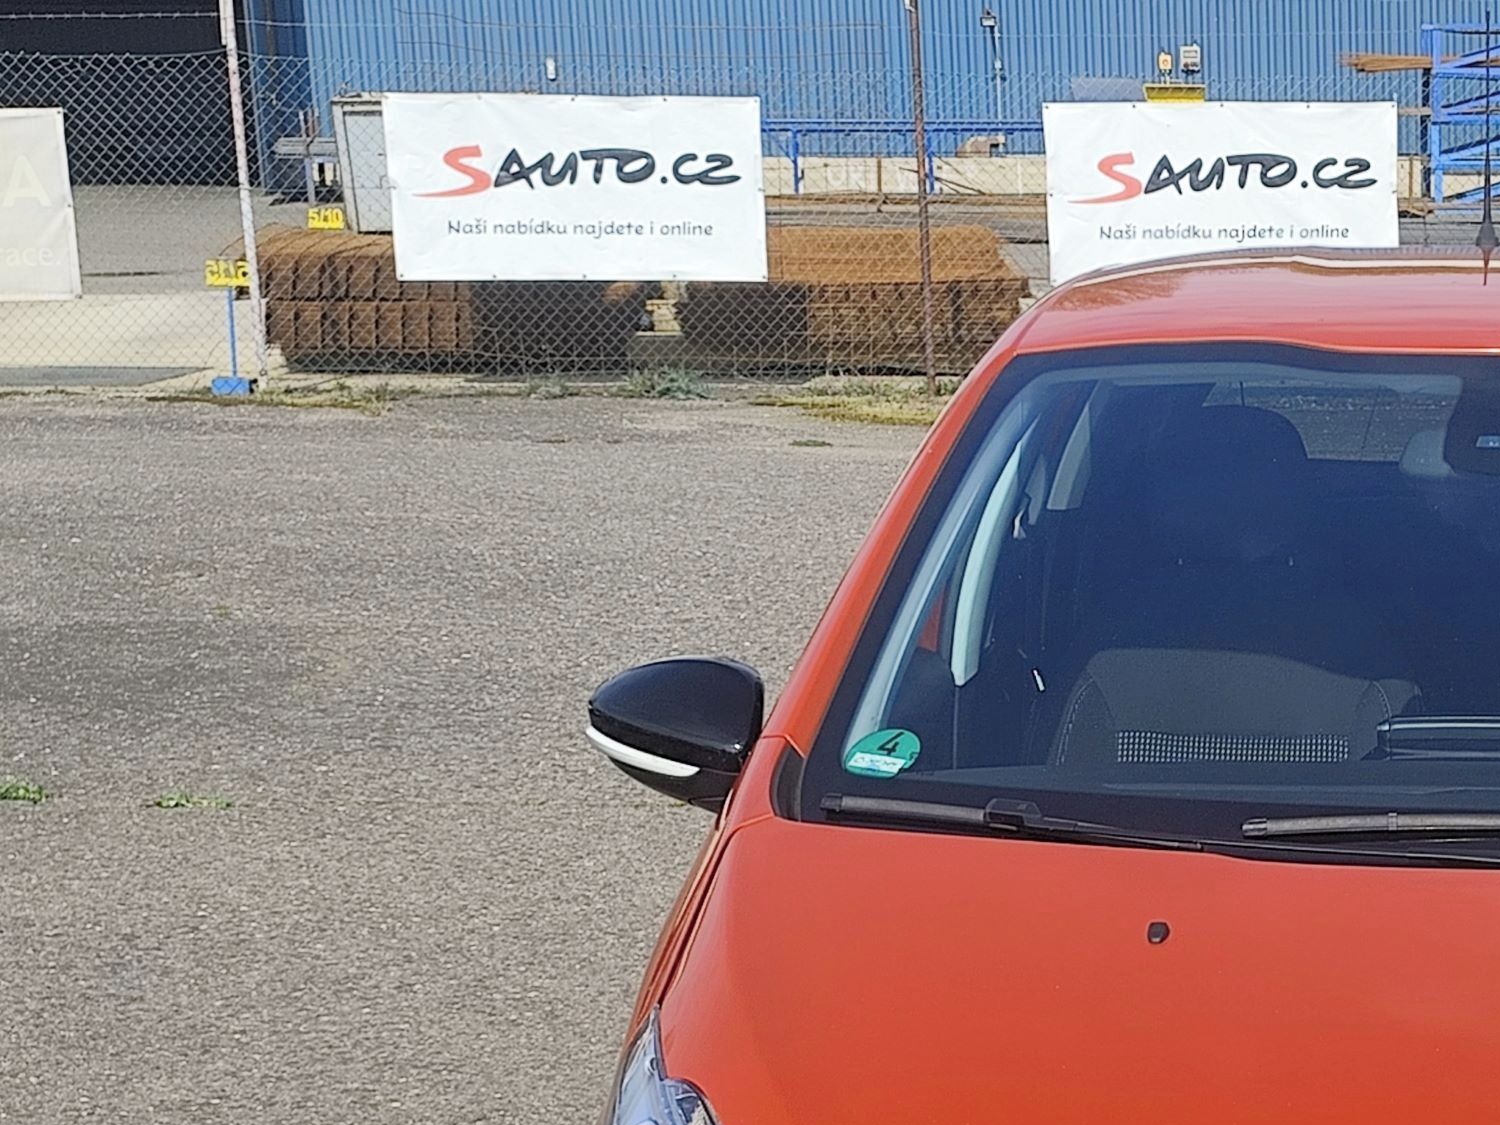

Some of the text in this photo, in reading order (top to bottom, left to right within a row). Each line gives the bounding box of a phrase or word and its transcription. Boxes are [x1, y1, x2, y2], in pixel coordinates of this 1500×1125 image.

[448, 218, 714, 239] Naši nabídku najdete i online
[1099, 223, 1350, 243] Naši nabídku najdete i online
[877, 732, 905, 756] 4
